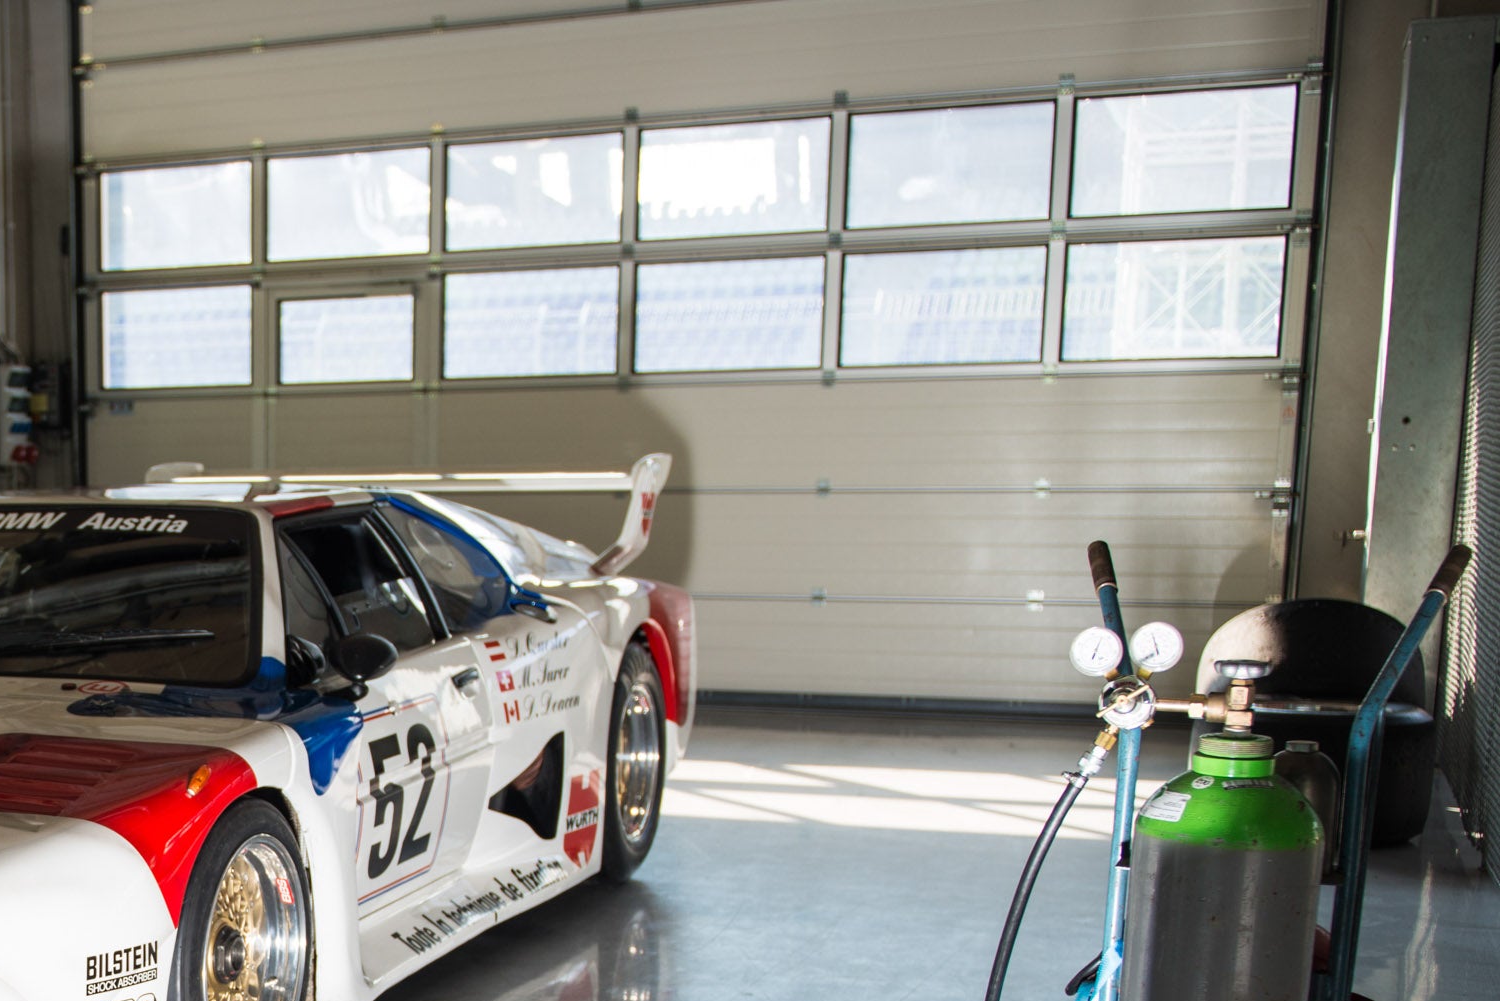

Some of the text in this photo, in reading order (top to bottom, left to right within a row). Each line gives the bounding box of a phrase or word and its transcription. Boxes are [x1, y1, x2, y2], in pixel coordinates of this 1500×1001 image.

[77, 512, 189, 534] Austria
[518, 665, 535, 688] M.
[367, 723, 437, 880] 52
[391, 926, 442, 955] Toute
[422, 913, 457, 936] la
[442, 890, 507, 924] technique
[493, 876, 527, 902] de
[86, 940, 159, 981] BILSTEIN
[87, 969, 158, 995] SHOCK ABSORBER
